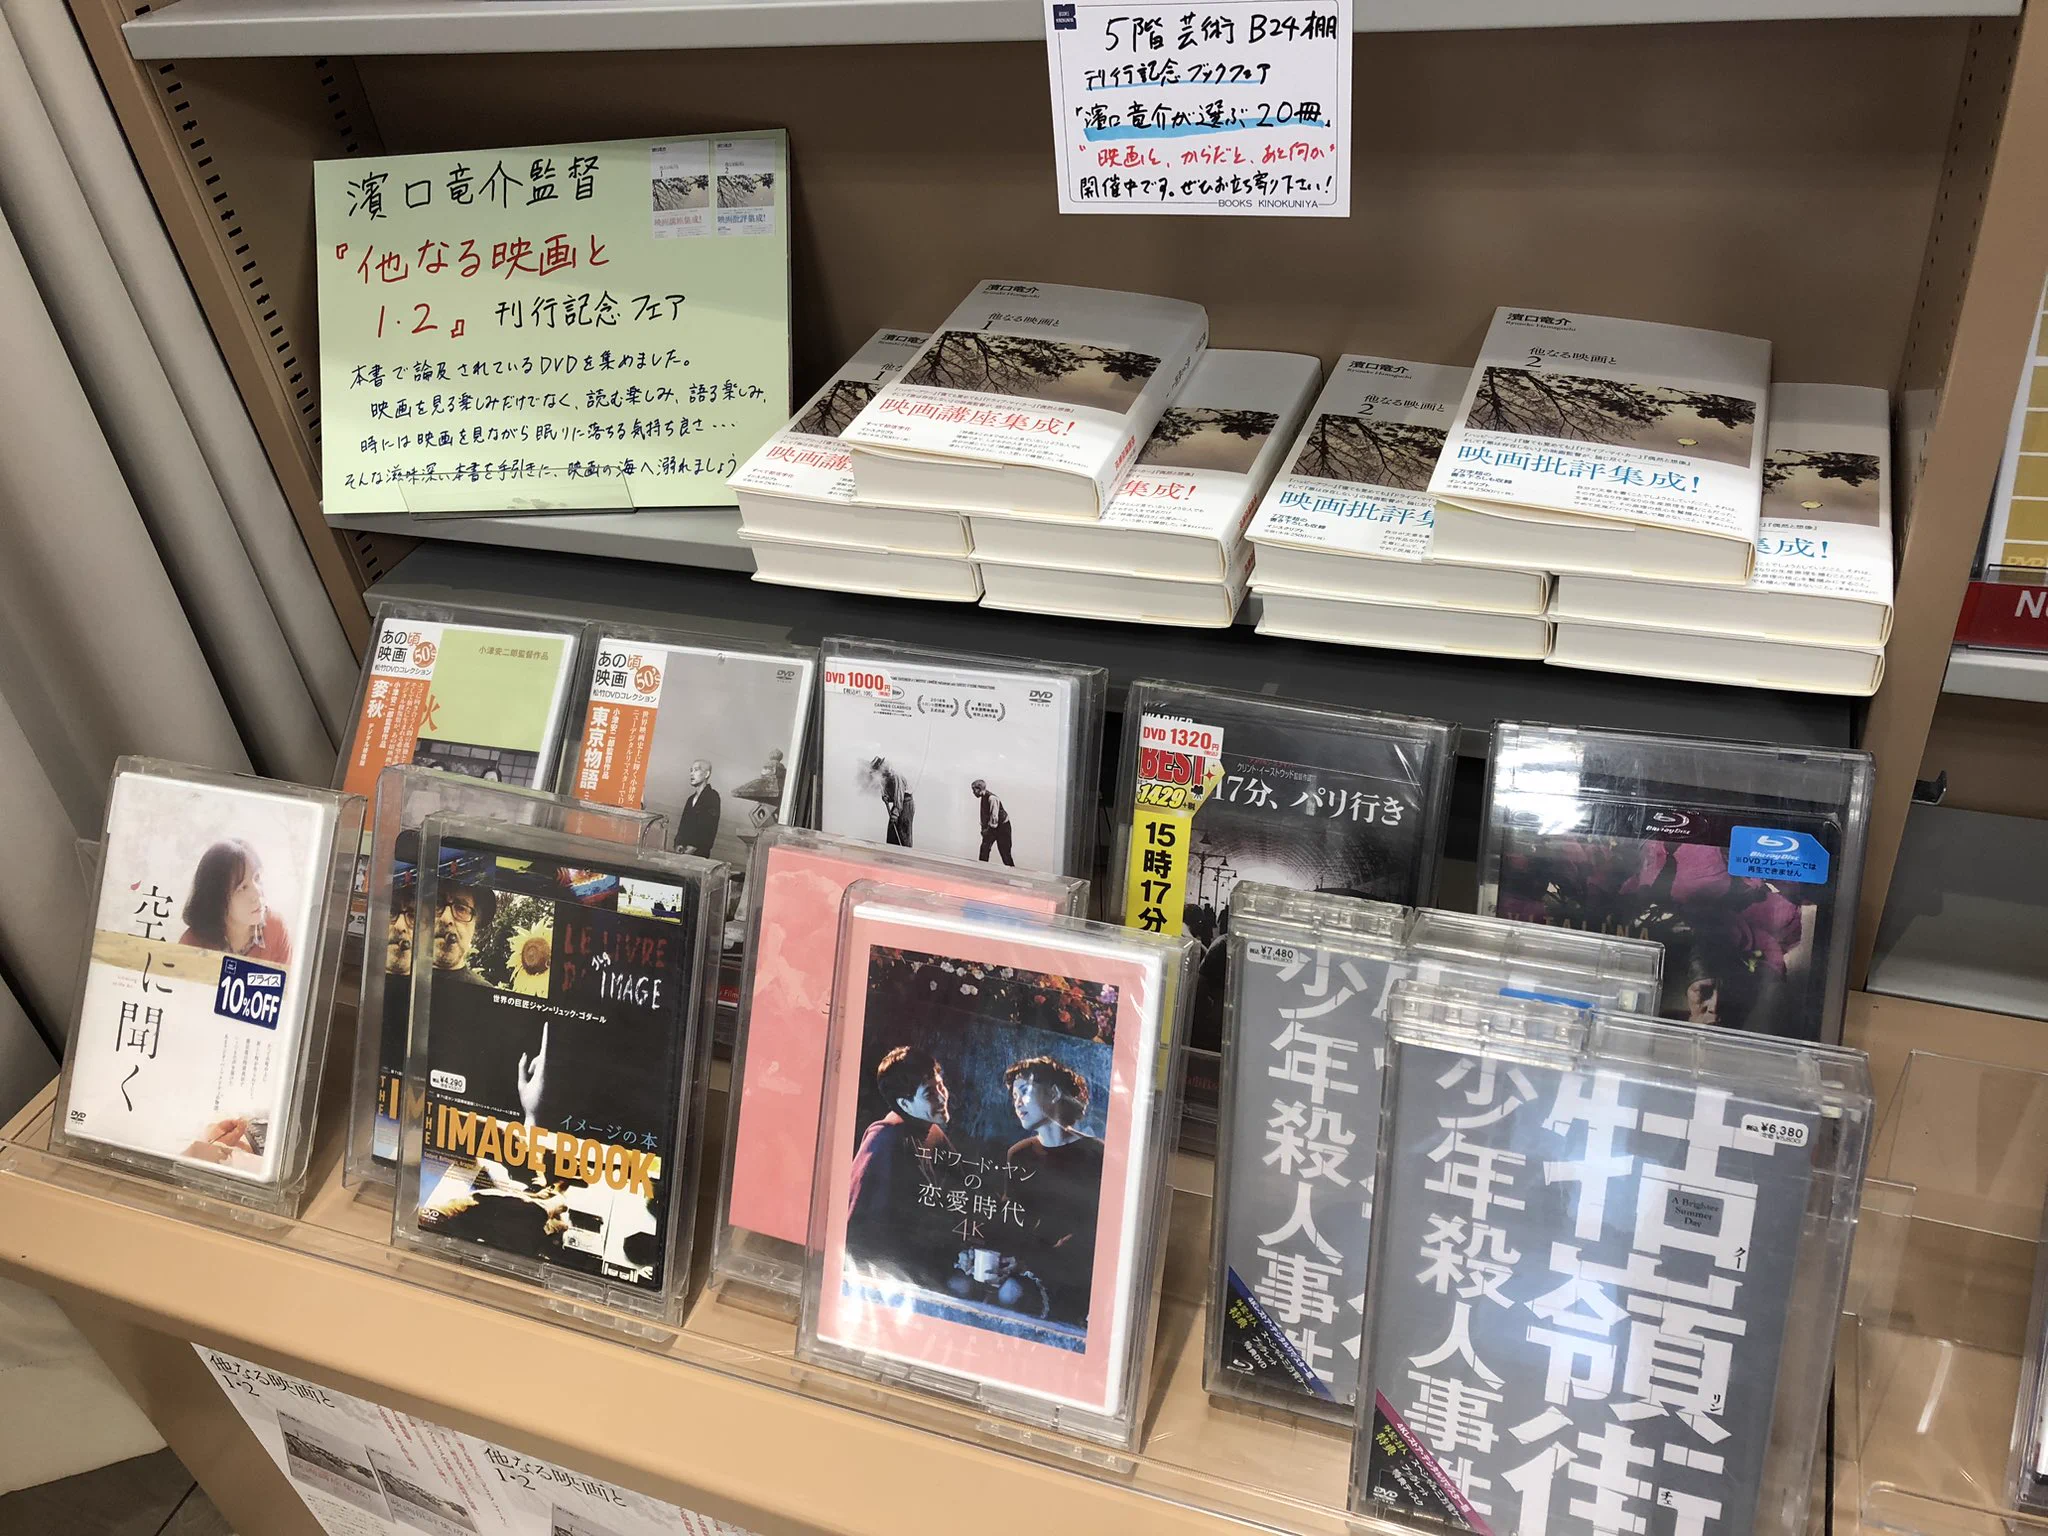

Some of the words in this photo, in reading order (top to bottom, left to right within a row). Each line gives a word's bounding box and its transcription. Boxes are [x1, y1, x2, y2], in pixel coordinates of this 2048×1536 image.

[346, 155, 600, 220] 濱口竜介監督
[1218, 200, 1253, 208] BOOKS
[1258, 200, 1319, 208] KINOKUNIYA
[988, 312, 1061, 327] 他なる映画と
[1507, 312, 1572, 326] 濱口竜介
[1525, 356, 1542, 368] 2
[1528, 347, 1617, 365] 他なる映画と
[872, 371, 885, 381] 1
[1349, 361, 1409, 374] 濱口竜介
[1358, 403, 1374, 415] 2
[1364, 394, 1445, 412] 他なる映画と
[878, 398, 1076, 436] 映画講座集成!
[1457, 446, 1700, 493] 映画批評集成!
[2014, 589, 2048, 618] N
[381, 630, 421, 646] あの頃
[377, 647, 408, 663] 映画
[479, 646, 549, 661] 小津安二郎監督作品
[598, 651, 643, 671] あの頃
[595, 669, 628, 689] 映画
[776, 669, 795, 680] DVD
[825, 671, 845, 684] DVD
[848, 672, 891, 692] 1000円
[592, 689, 657, 703] 松竹DVDコレクション
[1029, 690, 1053, 700] DVD
[1143, 726, 1166, 741] DVD
[1170, 728, 1220, 751] 1320円
[580, 707, 610, 790] 東京物語
[1747, 866, 1802, 878] 再生できません
[1261, 945, 1294, 959] ¥7,480
[601, 970, 662, 1010] IMAGE
[115, 885, 174, 1113] 空に聞く
[378, 1075, 386, 1116] THE
[560, 1114, 658, 1149] イメージの本
[1761, 1122, 1803, 1139] ¥6,380
[914, 1147, 1037, 1182] エドワード・ヤン
[964, 1173, 982, 1190] の
[917, 1183, 1026, 1228] 恋愛時代
[1675, 1206, 1712, 1221] Summer
[951, 1218, 985, 1241] 4K
[210, 1355, 336, 1409] 他なる映画と
[1710, 1394, 1721, 1411] リン
[484, 1447, 627, 1507] 他なる映画と
[1373, 1486, 1398, 1498] DVD
